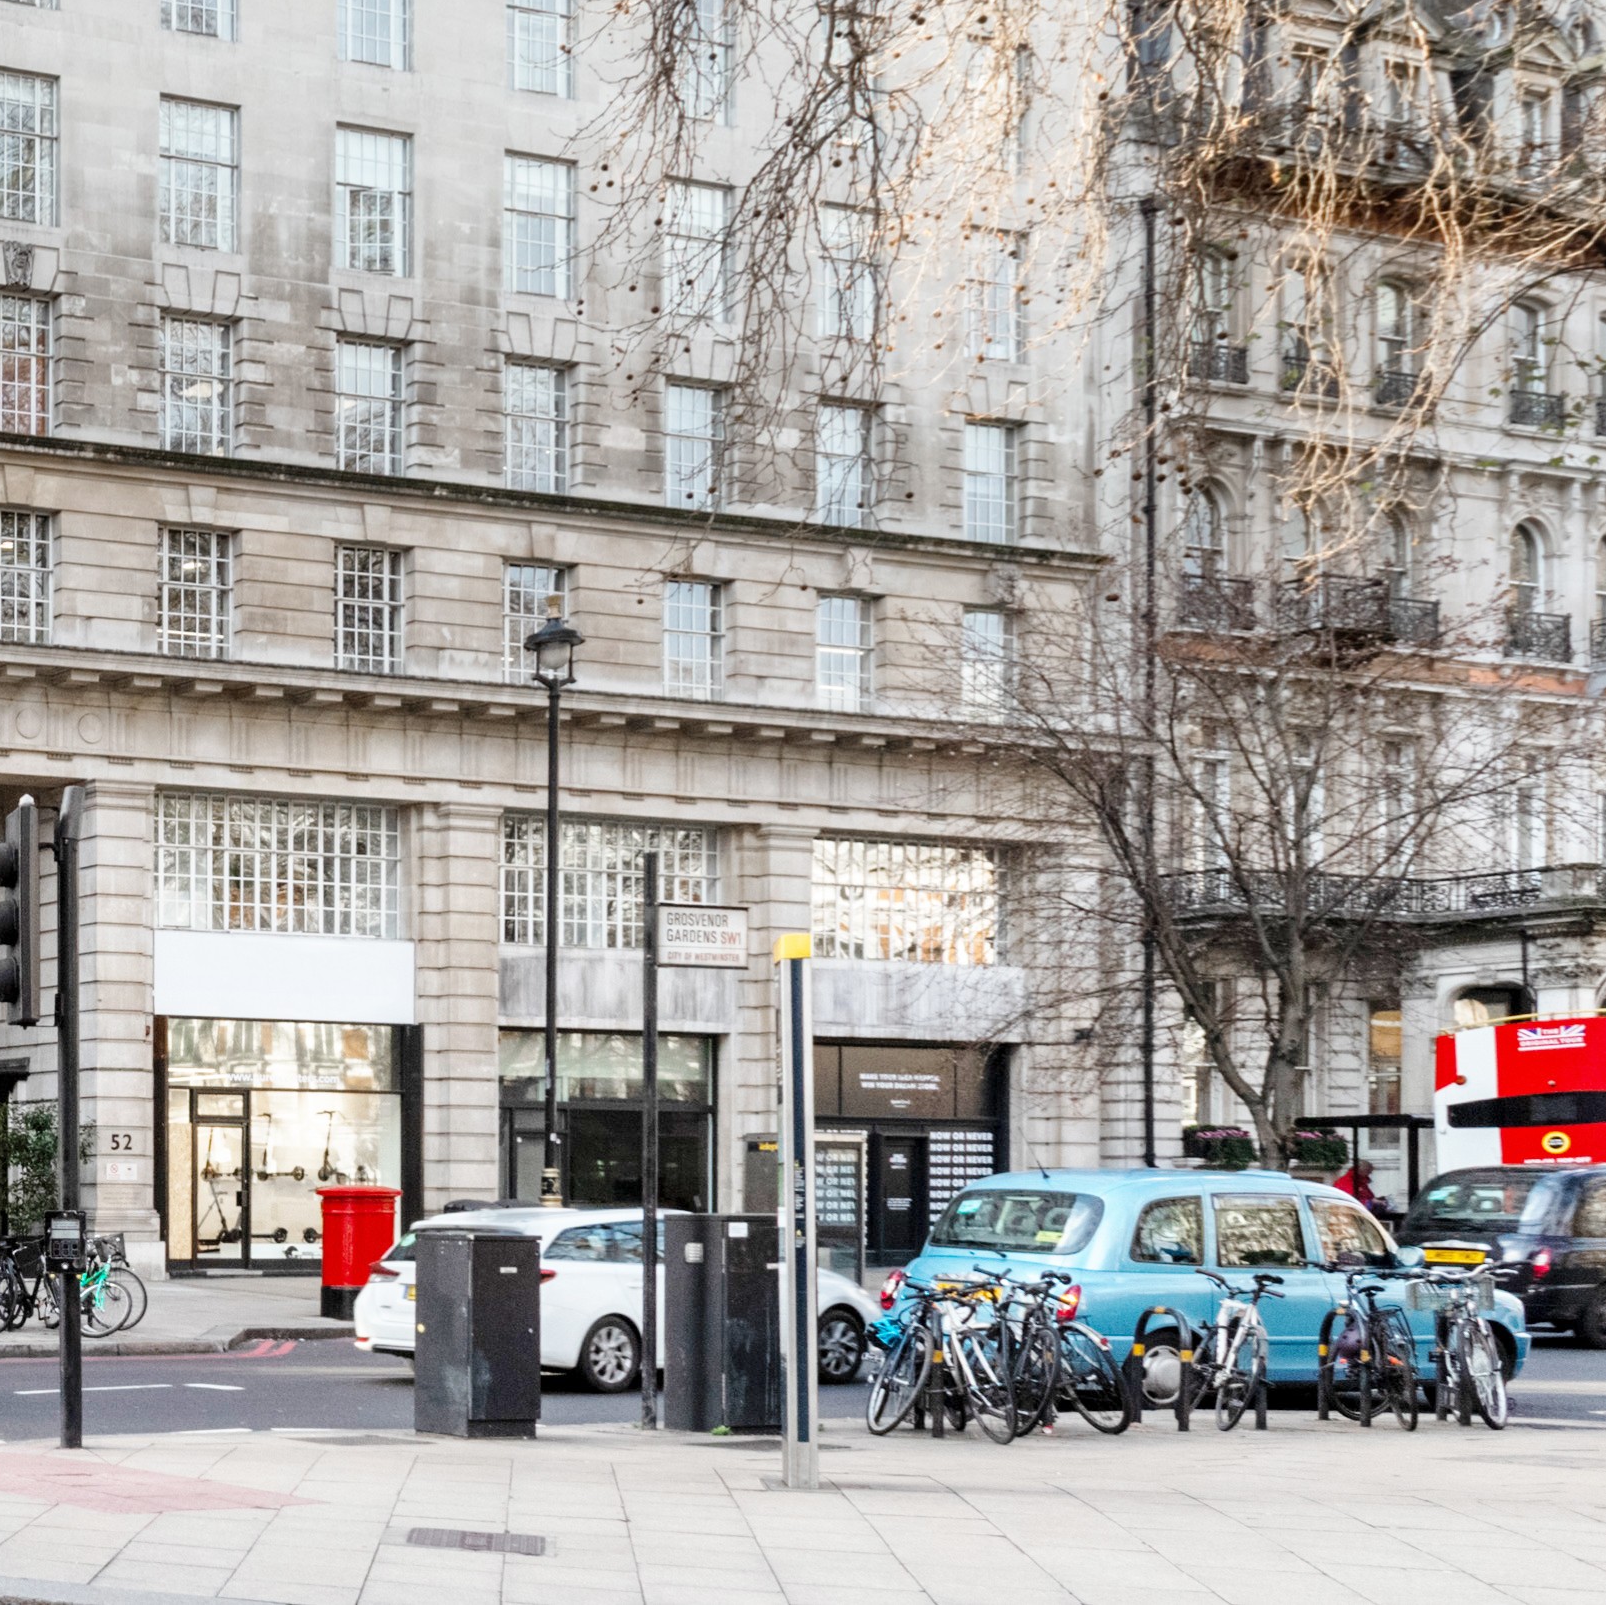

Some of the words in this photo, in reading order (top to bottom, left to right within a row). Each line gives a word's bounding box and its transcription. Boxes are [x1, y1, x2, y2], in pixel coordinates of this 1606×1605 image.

[666, 912, 729, 927] GROSVENOR
[666, 928, 718, 944] GARDENS
[720, 931, 742, 945] SW1
[930, 1132, 951, 1140] NOW
[952, 1132, 964, 1140] OR
[966, 1132, 993, 1141] NEVER
[111, 1134, 132, 1150] 52
[930, 1144, 951, 1152] NOW
[952, 1144, 964, 1152] OR
[966, 1144, 993, 1153] NEVER
[930, 1155, 951, 1163] NOW
[952, 1155, 964, 1163] OR
[966, 1155, 993, 1164] NEVER
[930, 1167, 951, 1175] NOW
[952, 1167, 964, 1175] OR
[966, 1167, 993, 1176] NEVER
[930, 1179, 951, 1187] NOW
[952, 1179, 964, 1187] OR
